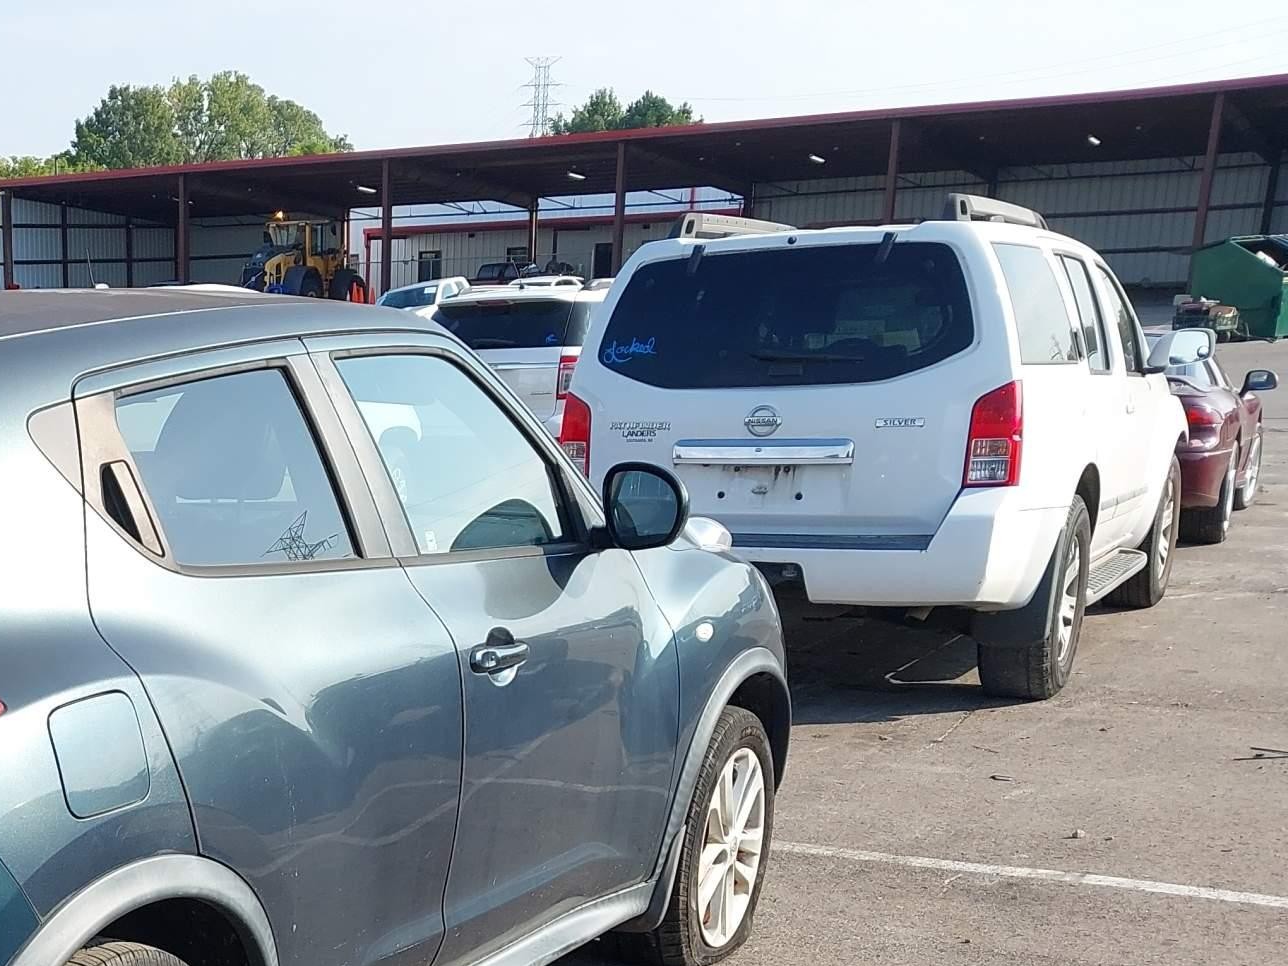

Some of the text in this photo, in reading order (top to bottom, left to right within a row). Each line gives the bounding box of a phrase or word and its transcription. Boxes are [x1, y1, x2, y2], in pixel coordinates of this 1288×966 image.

[747, 417, 778, 425] NISSAN
[882, 418, 917, 426] SILVER
[609, 421, 672, 431] PATHFINDER
[622, 430, 657, 438] LANDERS
